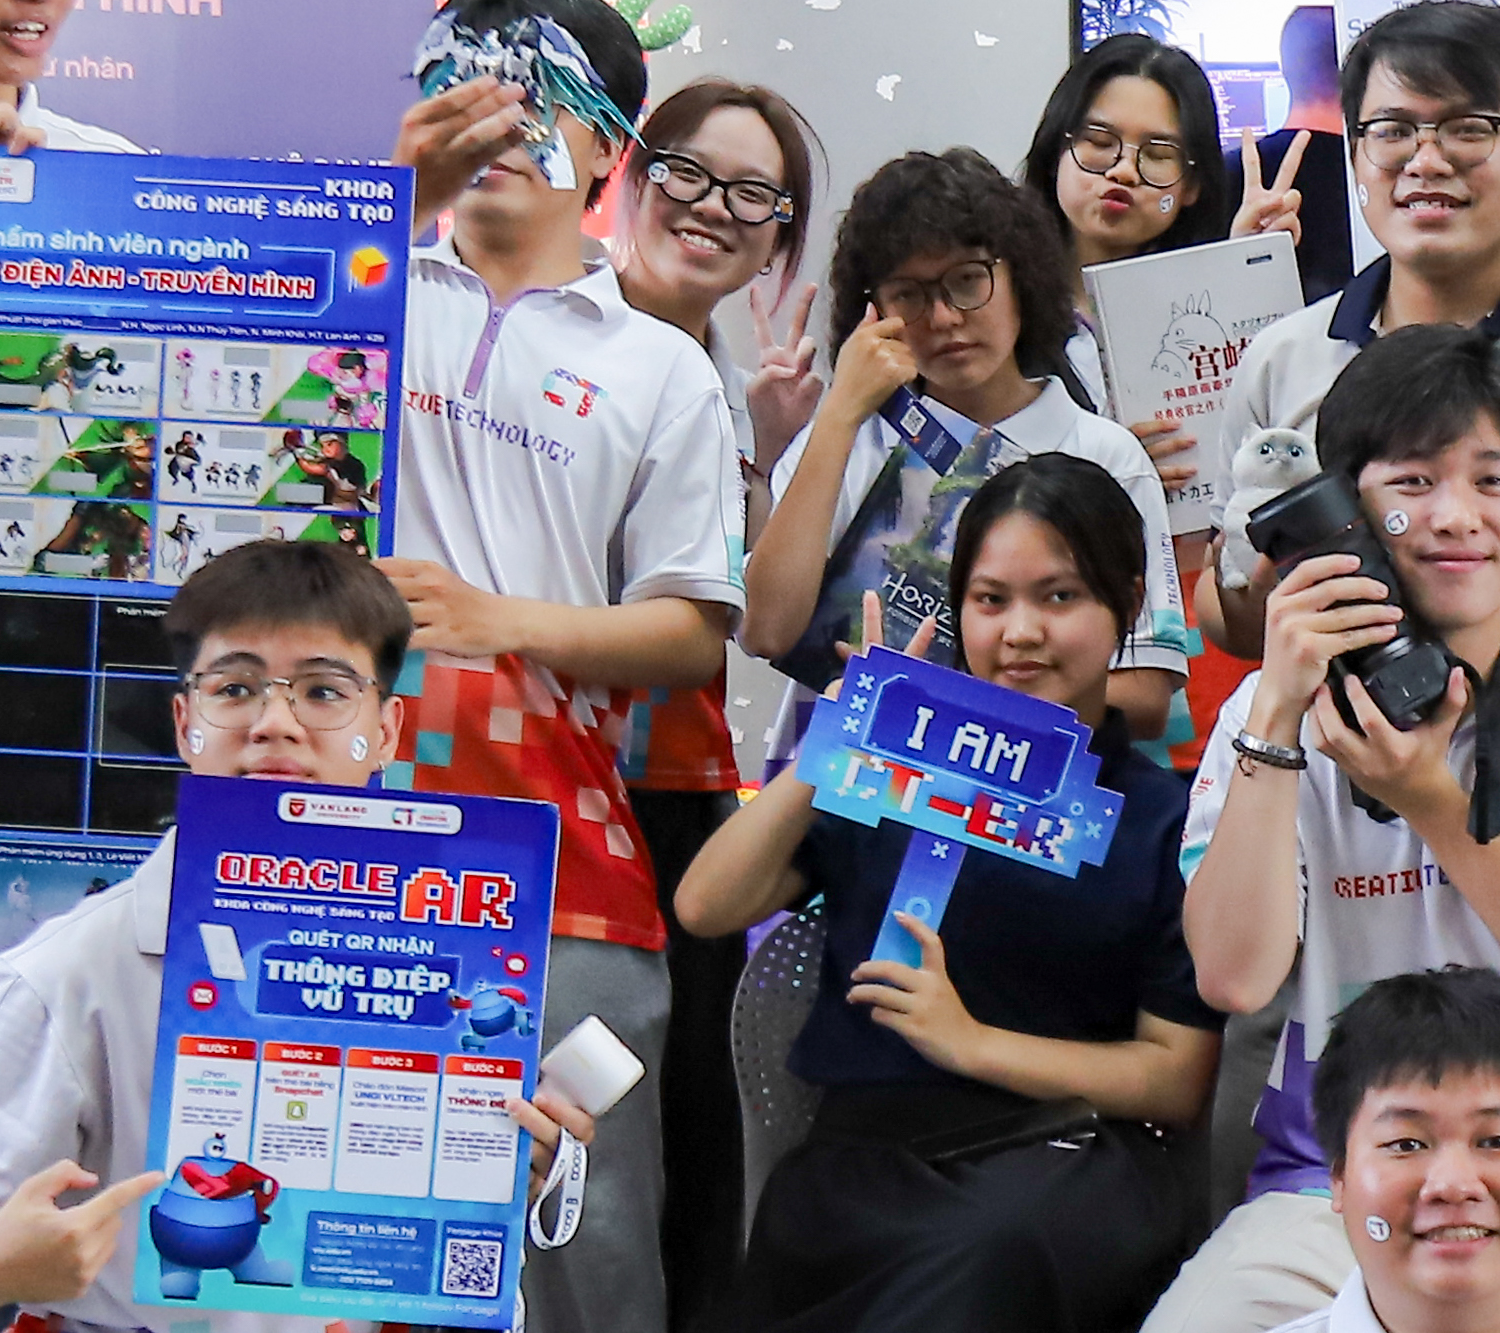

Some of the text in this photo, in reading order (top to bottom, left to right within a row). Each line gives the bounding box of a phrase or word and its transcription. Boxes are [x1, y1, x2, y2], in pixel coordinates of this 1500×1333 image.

[65, 53, 134, 80] nhân
[324, 178, 395, 201] KHOA
[134, 189, 394, 226] CÔNG NGHỆ SÁNG TẠO
[50, 230, 103, 252] sinh
[108, 233, 165, 256] viên
[168, 235, 249, 264] ngành
[2, 258, 64, 290] ĐIỆN
[65, 261, 127, 289] ẢNH
[142, 264, 243, 296] TRUYỀN
[246, 269, 316, 300] HÌNH
[907, 704, 1032, 783] I AM
[311, 803, 368, 815] VANLANG
[216, 850, 516, 930] ORACLE AR
[213, 897, 250, 912] KHOA
[252, 899, 289, 915] CÔNG
[288, 928, 435, 957] QUÉT QR NHẬN
[263, 956, 451, 1001] THÔNG ĐIỆP
[301, 985, 415, 1021] VŨ TRỤ
[197, 1041, 230, 1055] BƯỚC
[281, 1047, 314, 1061] BƯỚC
[371, 1054, 414, 1068] BƯỚC 3
[462, 1061, 505, 1075] BƯỚC 4
[316, 1219, 357, 1235] Thông
[359, 1222, 375, 1234] tin
[377, 1224, 399, 1236] liên
